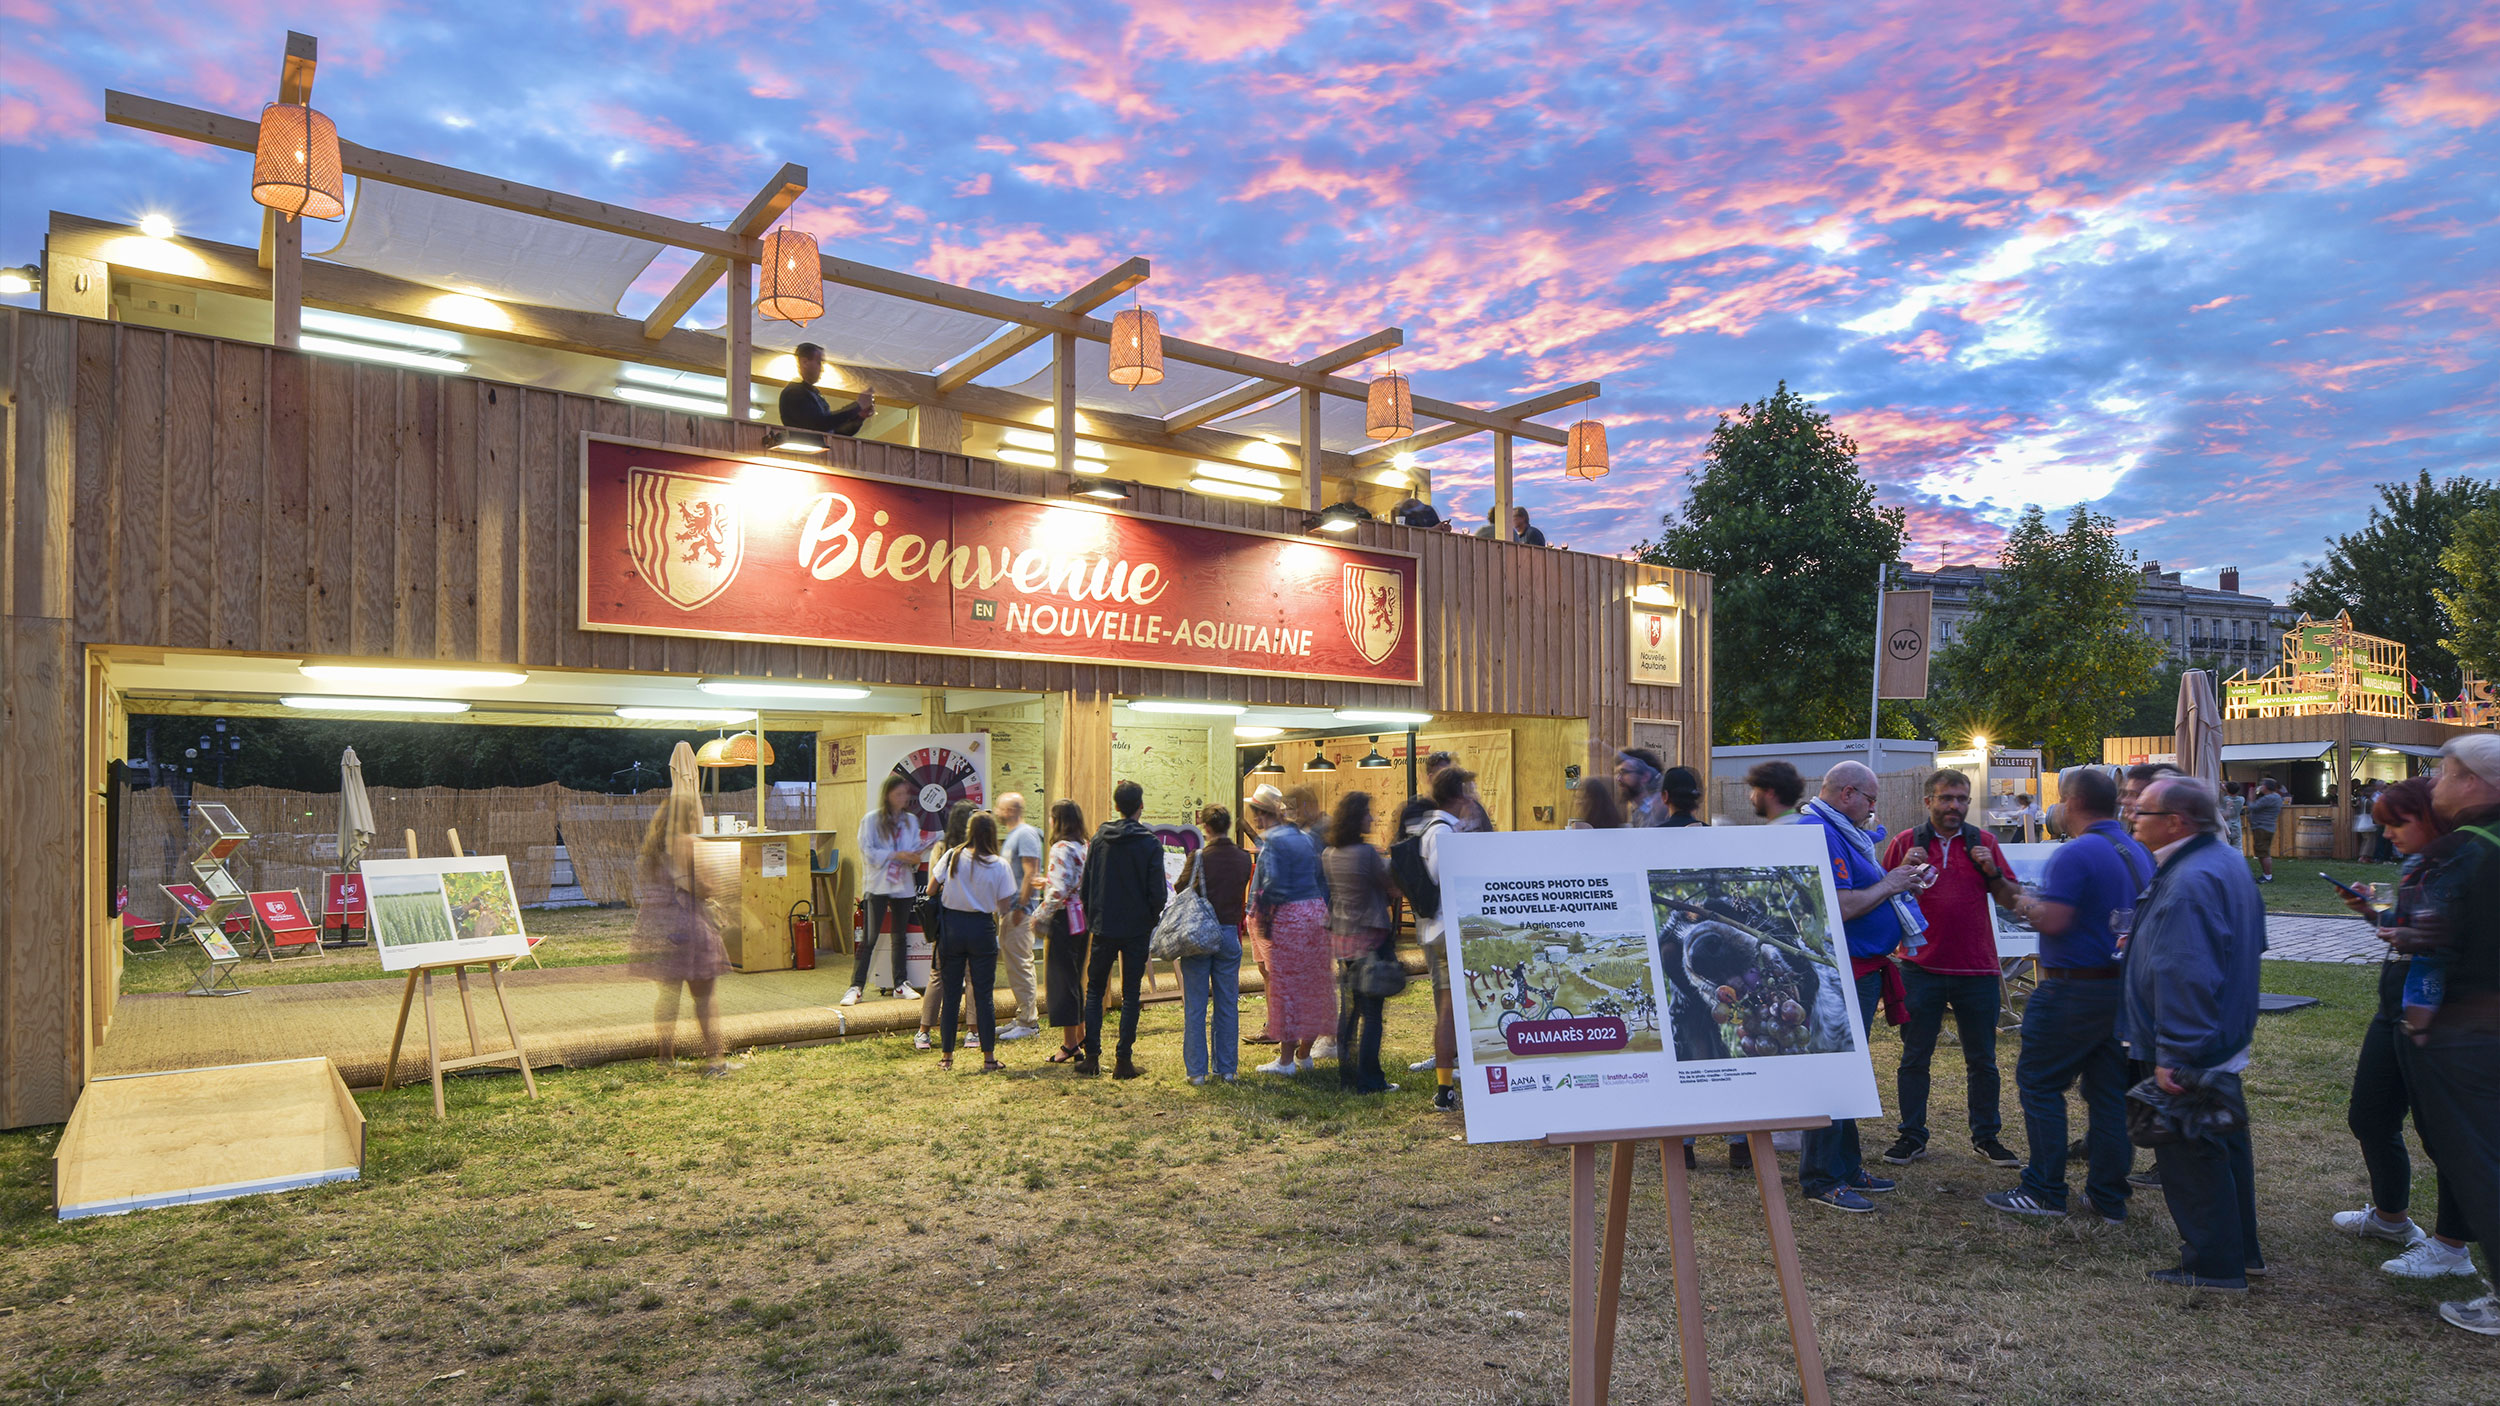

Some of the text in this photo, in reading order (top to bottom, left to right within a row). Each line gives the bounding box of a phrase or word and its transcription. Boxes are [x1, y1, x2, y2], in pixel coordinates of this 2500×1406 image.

[798, 492, 1169, 605] Bienvenue
[975, 602, 1313, 656] EN NOUVELLE-AQUITAINE
[1893, 640, 1917, 650] WC
[2300, 627, 2334, 672] 5
[1641, 652, 1667, 661] Nouvelle-
[1641, 661, 1667, 671] Aquitaine
[2256, 695, 2329, 704] NOUVELLE-AQUITAINE
[1995, 758, 2033, 766] TOILETTES
[1834, 858, 1849, 879] 3
[1485, 878, 1609, 891] CONCOURS PHOTO DES
[1483, 890, 1614, 903] PAYSAGES NOURRICIERS
[1481, 901, 1618, 915] DE NOUVELLE-AQUITAINE
[1519, 920, 1585, 931] #Agrienscene
[1518, 1026, 1617, 1044] PALMARÈS 2022
[1511, 1076, 1536, 1086] AANA
